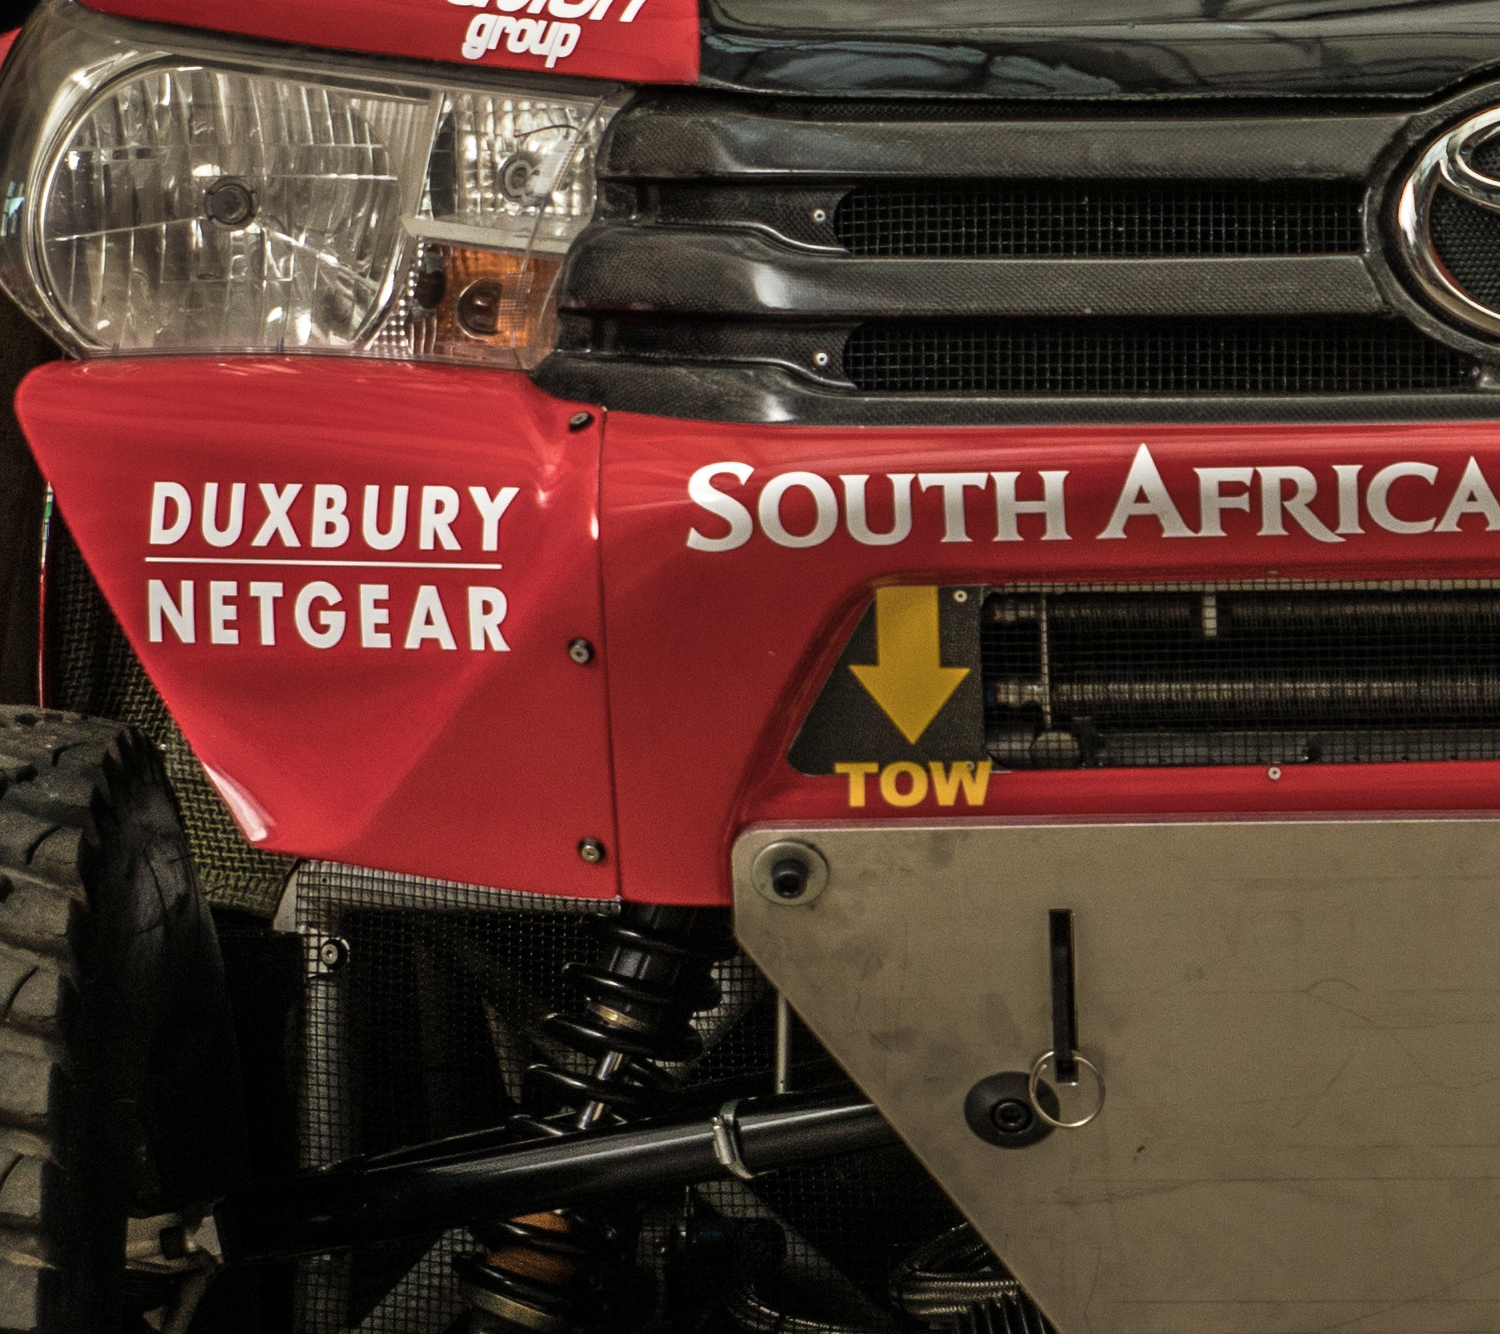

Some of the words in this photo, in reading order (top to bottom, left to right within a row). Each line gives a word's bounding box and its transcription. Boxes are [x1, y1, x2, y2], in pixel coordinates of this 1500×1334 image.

[461, 13, 581, 68] group
[149, 481, 521, 552] DUXBURY
[686, 461, 1073, 552] SOUTH
[148, 579, 511, 652] NETGEAR
[834, 760, 992, 808] TOW
